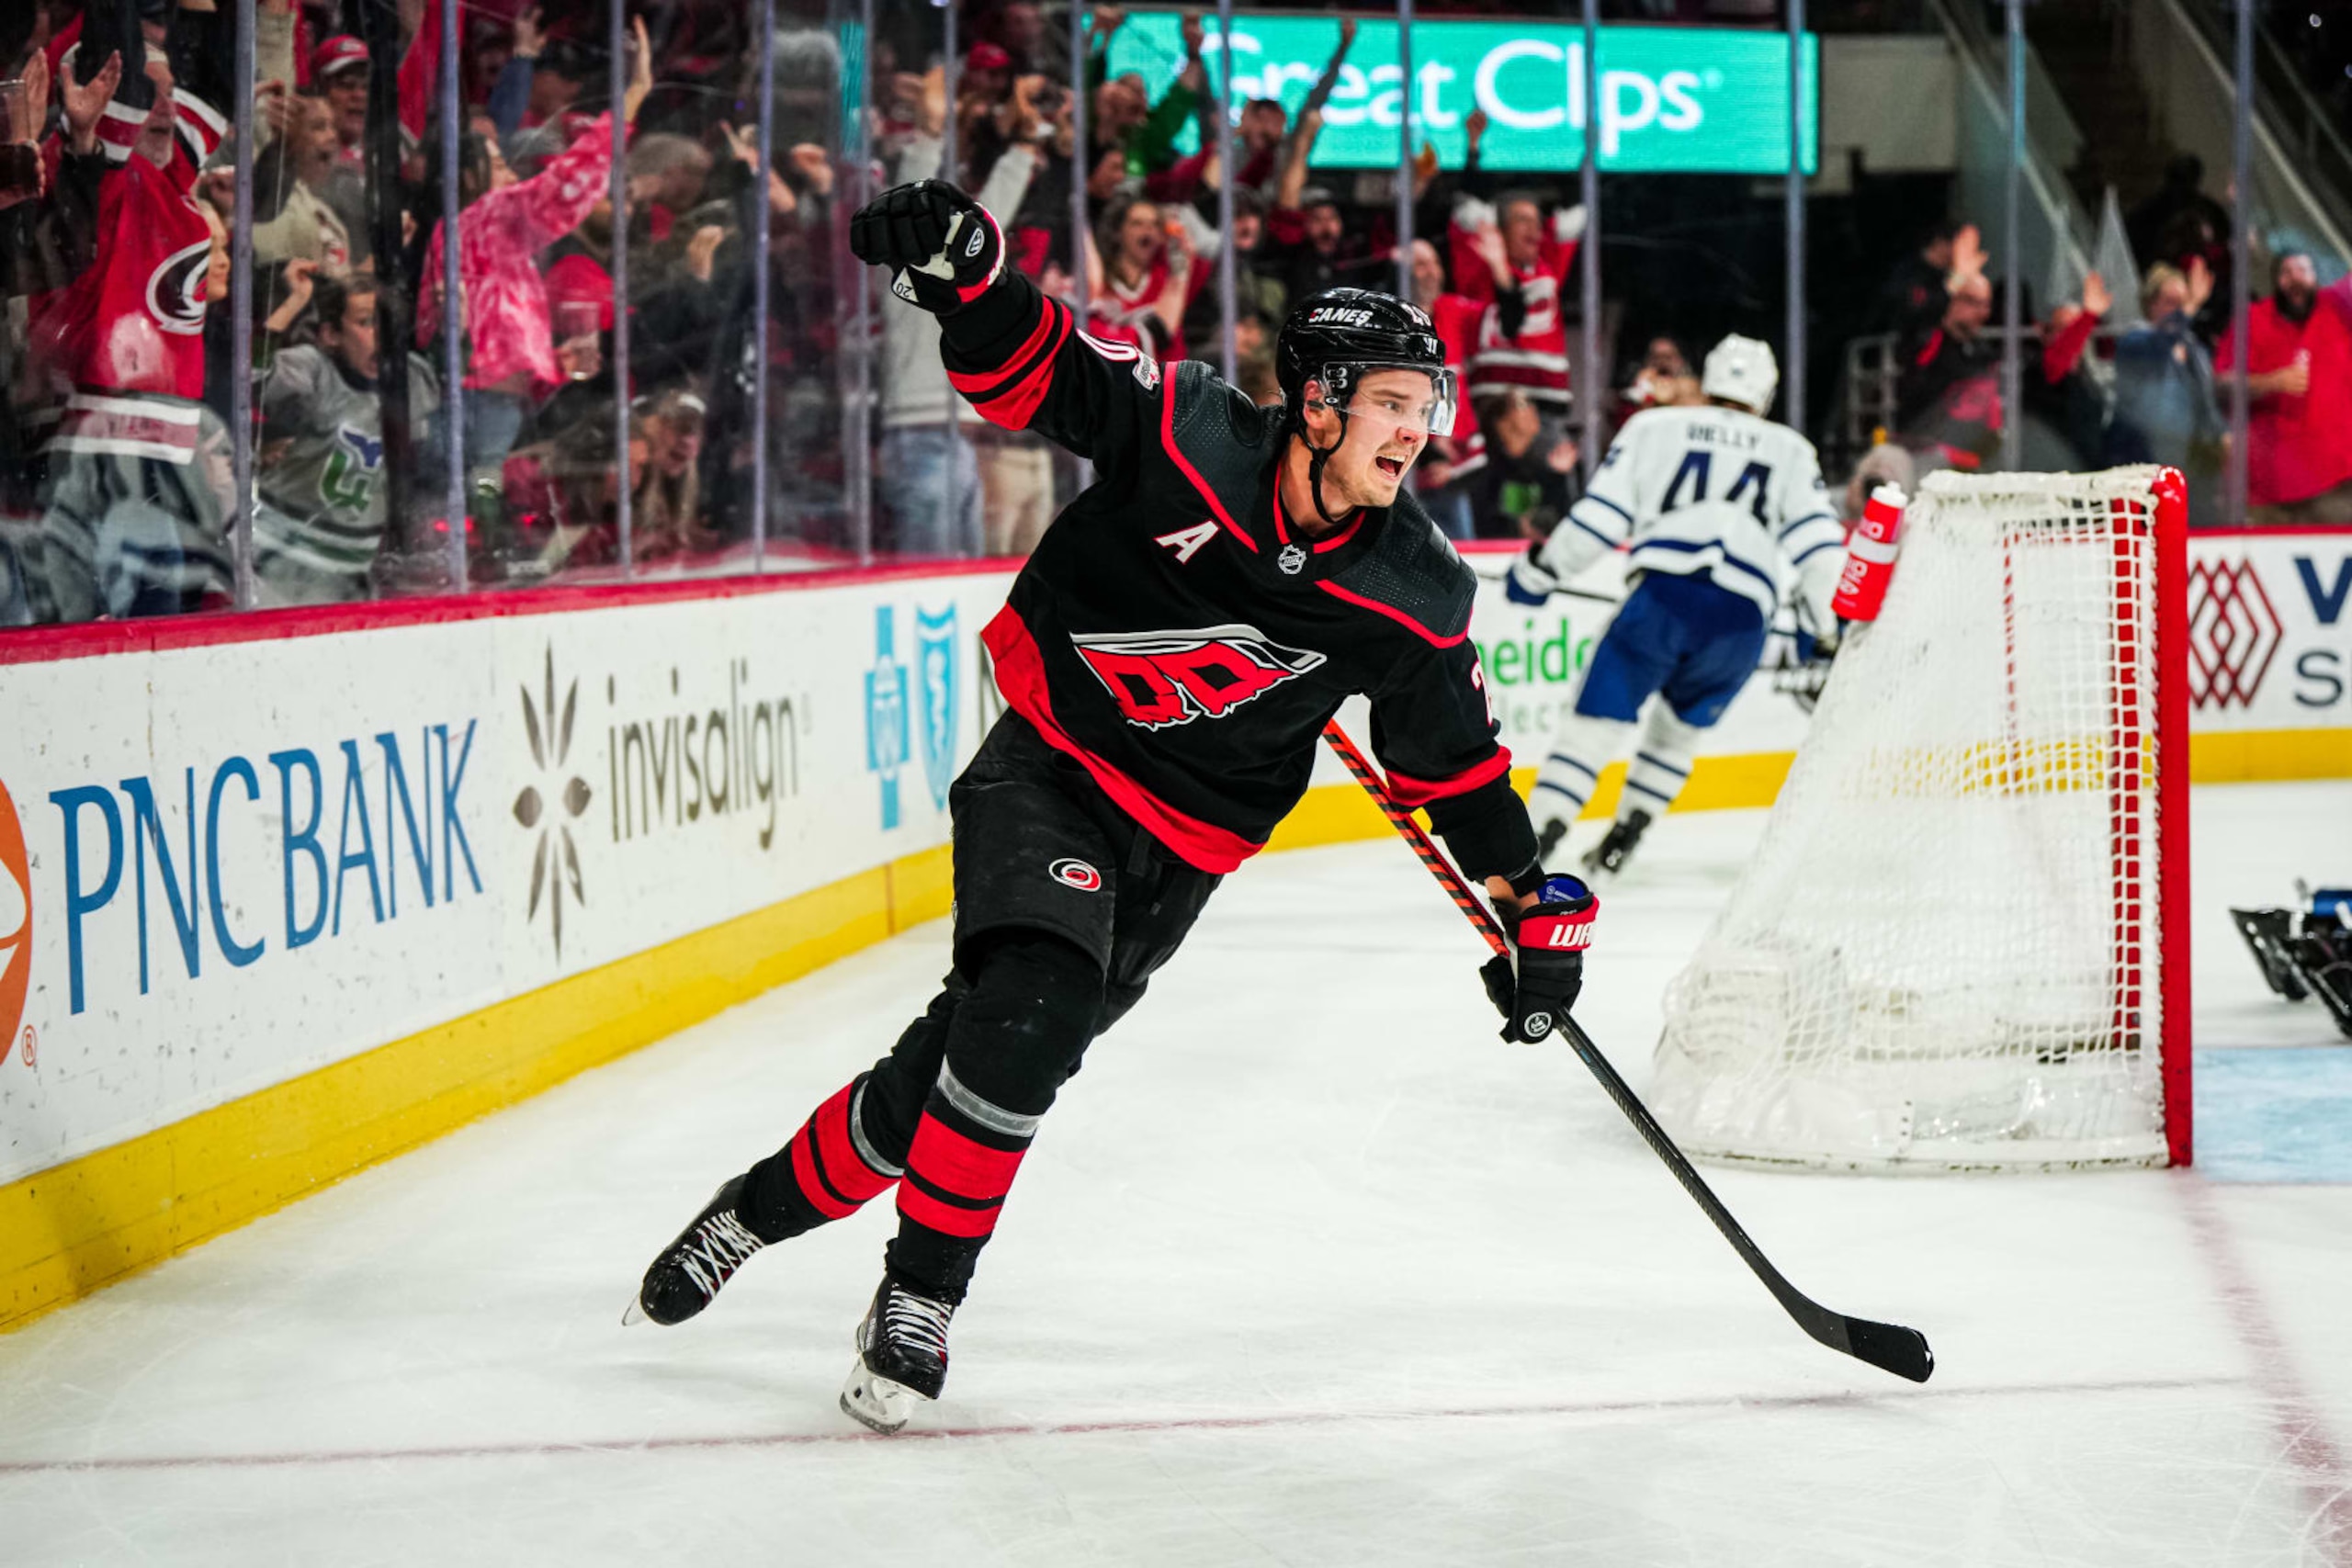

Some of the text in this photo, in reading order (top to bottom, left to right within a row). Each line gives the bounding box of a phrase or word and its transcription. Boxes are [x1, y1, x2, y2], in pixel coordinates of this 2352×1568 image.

[1308, 308, 1374, 323] CANES
[1153, 518, 1221, 565] A
[608, 658, 798, 851] invisalign
